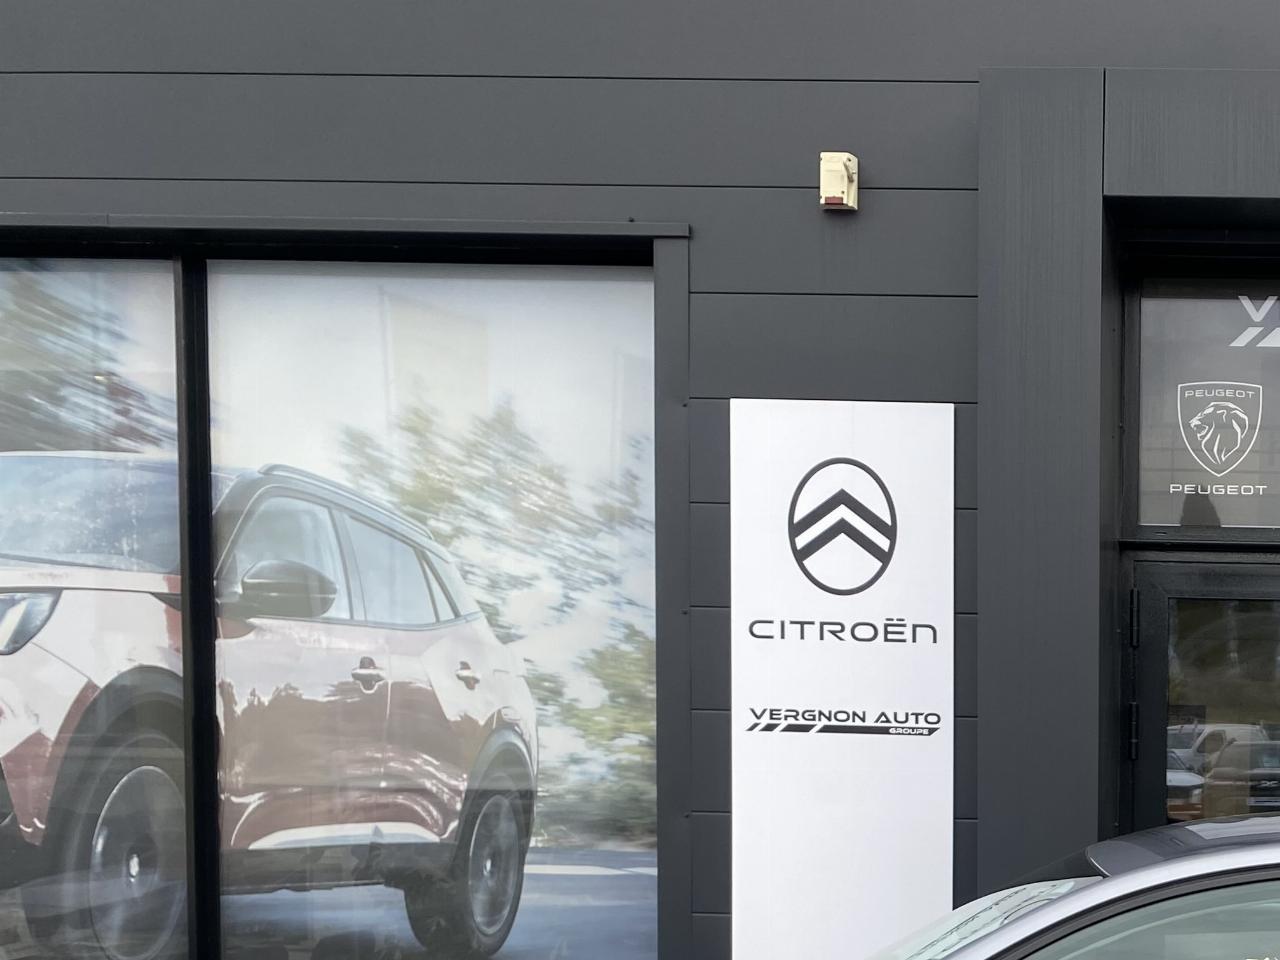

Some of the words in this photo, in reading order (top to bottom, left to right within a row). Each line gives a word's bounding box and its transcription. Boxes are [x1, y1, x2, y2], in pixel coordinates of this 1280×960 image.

[1184, 388, 1255, 399] PEUGEOT
[1169, 483, 1268, 496] PEUGEOT
[748, 617, 938, 644] CITROËN
[749, 708, 866, 723] VERGNON
[873, 711, 942, 725] AUTO
[888, 726, 931, 736] GROUPE
